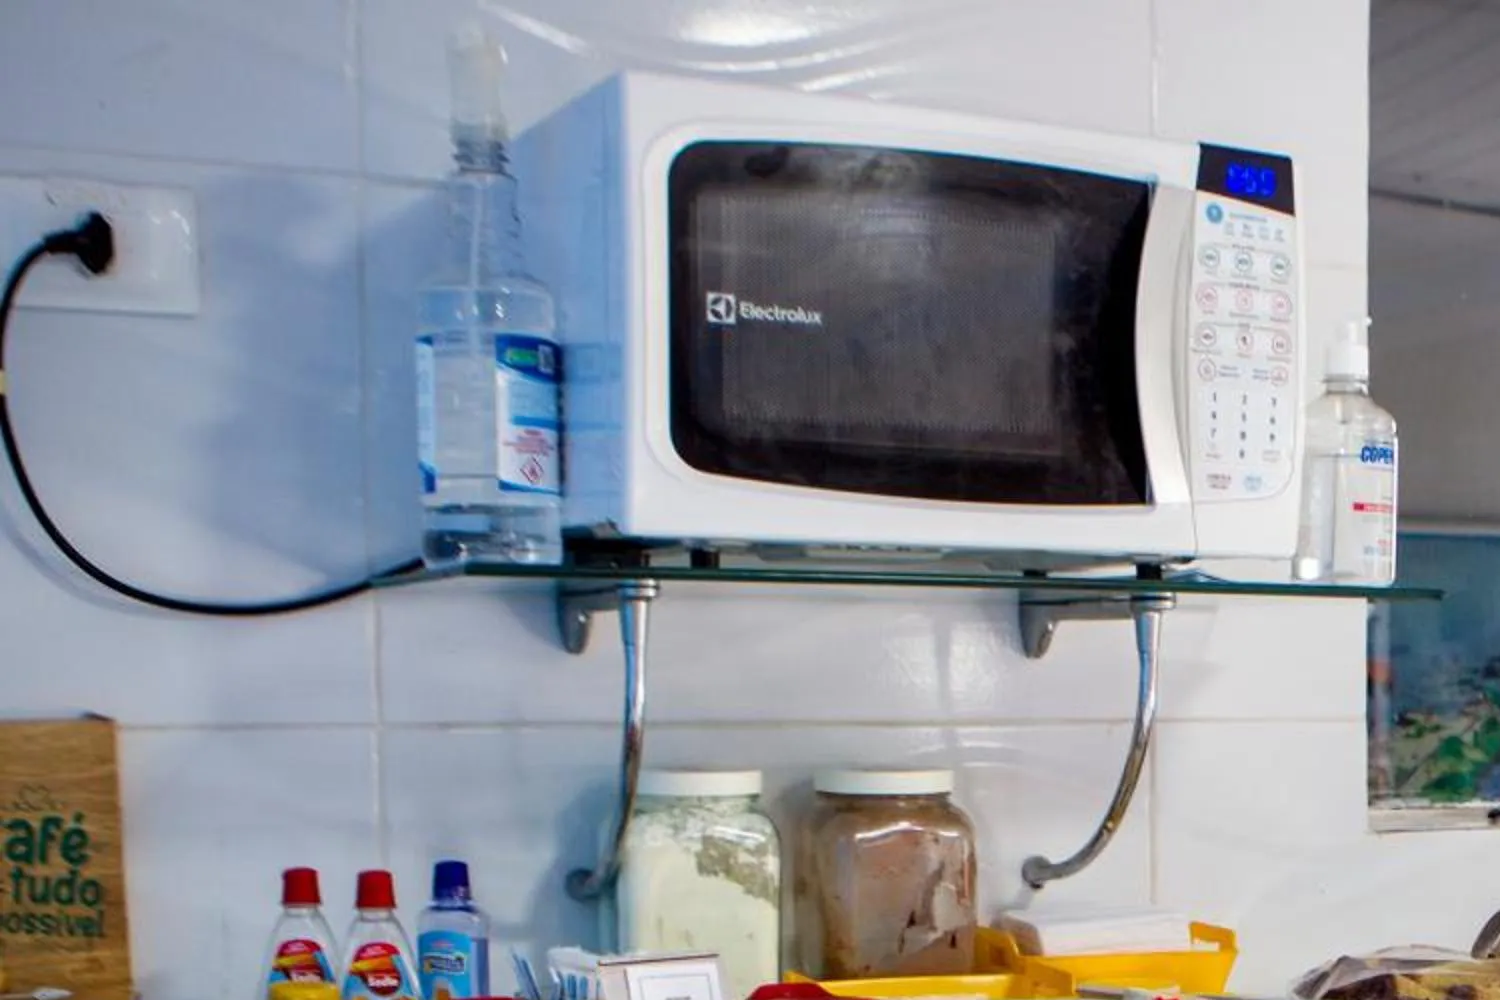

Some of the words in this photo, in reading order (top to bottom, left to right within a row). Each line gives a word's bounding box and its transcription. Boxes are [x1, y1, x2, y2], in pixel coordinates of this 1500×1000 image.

[739, 301, 822, 325] Electrolux
[0, 811, 90, 866] afé
[10, 865, 102, 907] tudo
